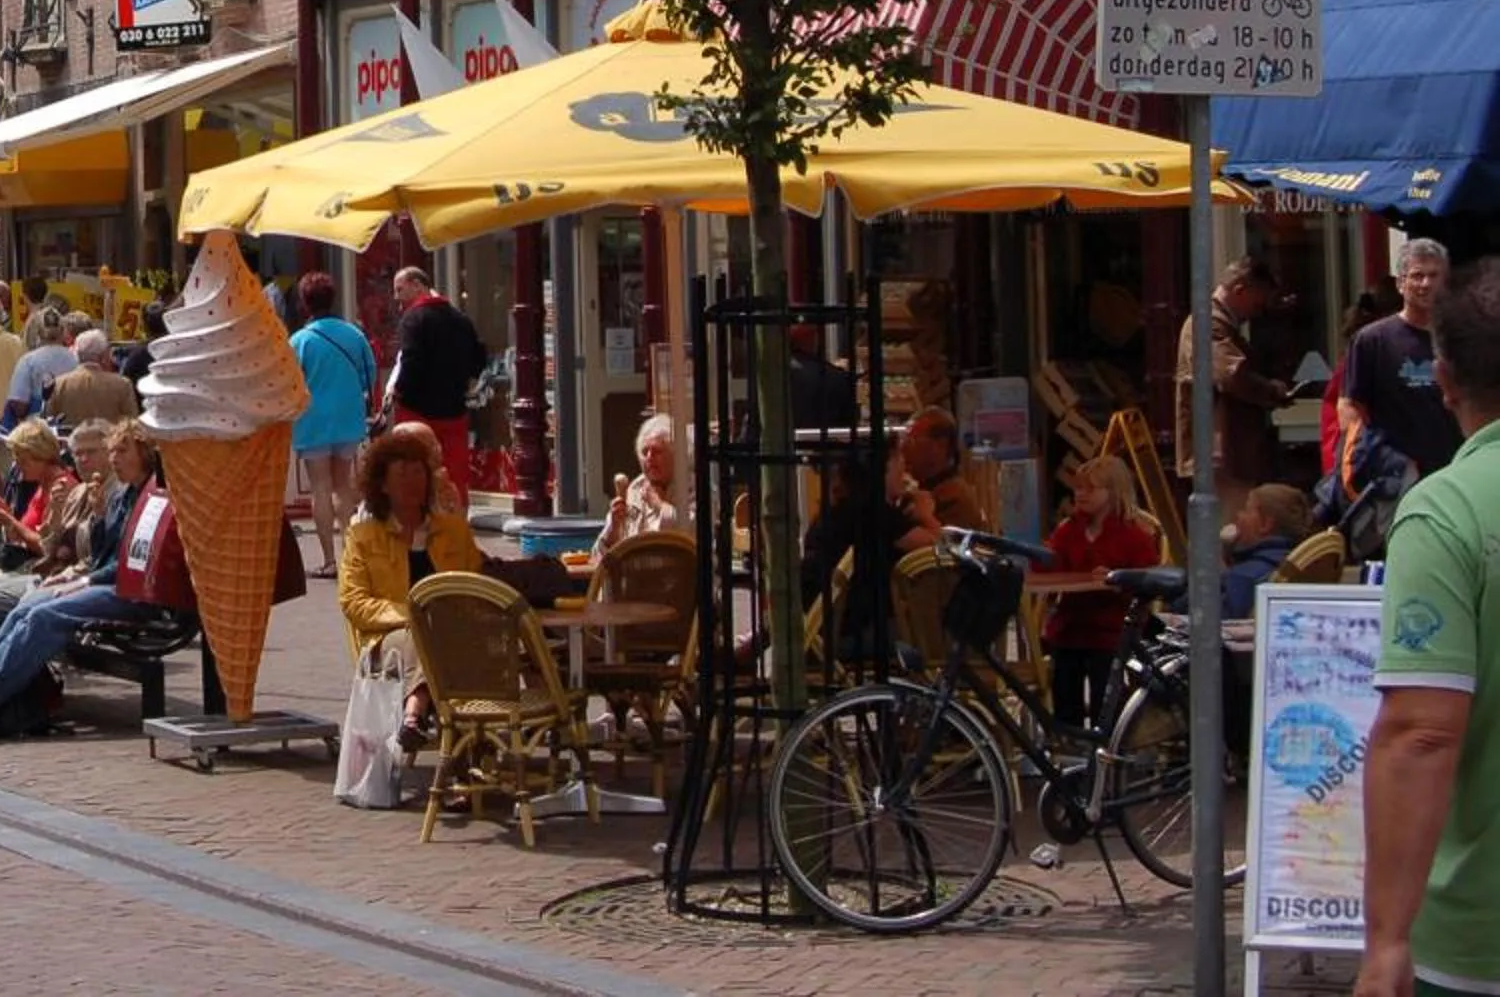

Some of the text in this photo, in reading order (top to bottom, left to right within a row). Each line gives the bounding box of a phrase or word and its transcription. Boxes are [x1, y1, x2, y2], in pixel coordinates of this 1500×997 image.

[156, 26, 180, 39] 022
[1110, 26, 1135, 44] zo
[1301, 27, 1314, 49] h
[1108, 52, 1226, 84] donderdag
[1301, 56, 1314, 81] h
[1304, 735, 1368, 806] DISCO
